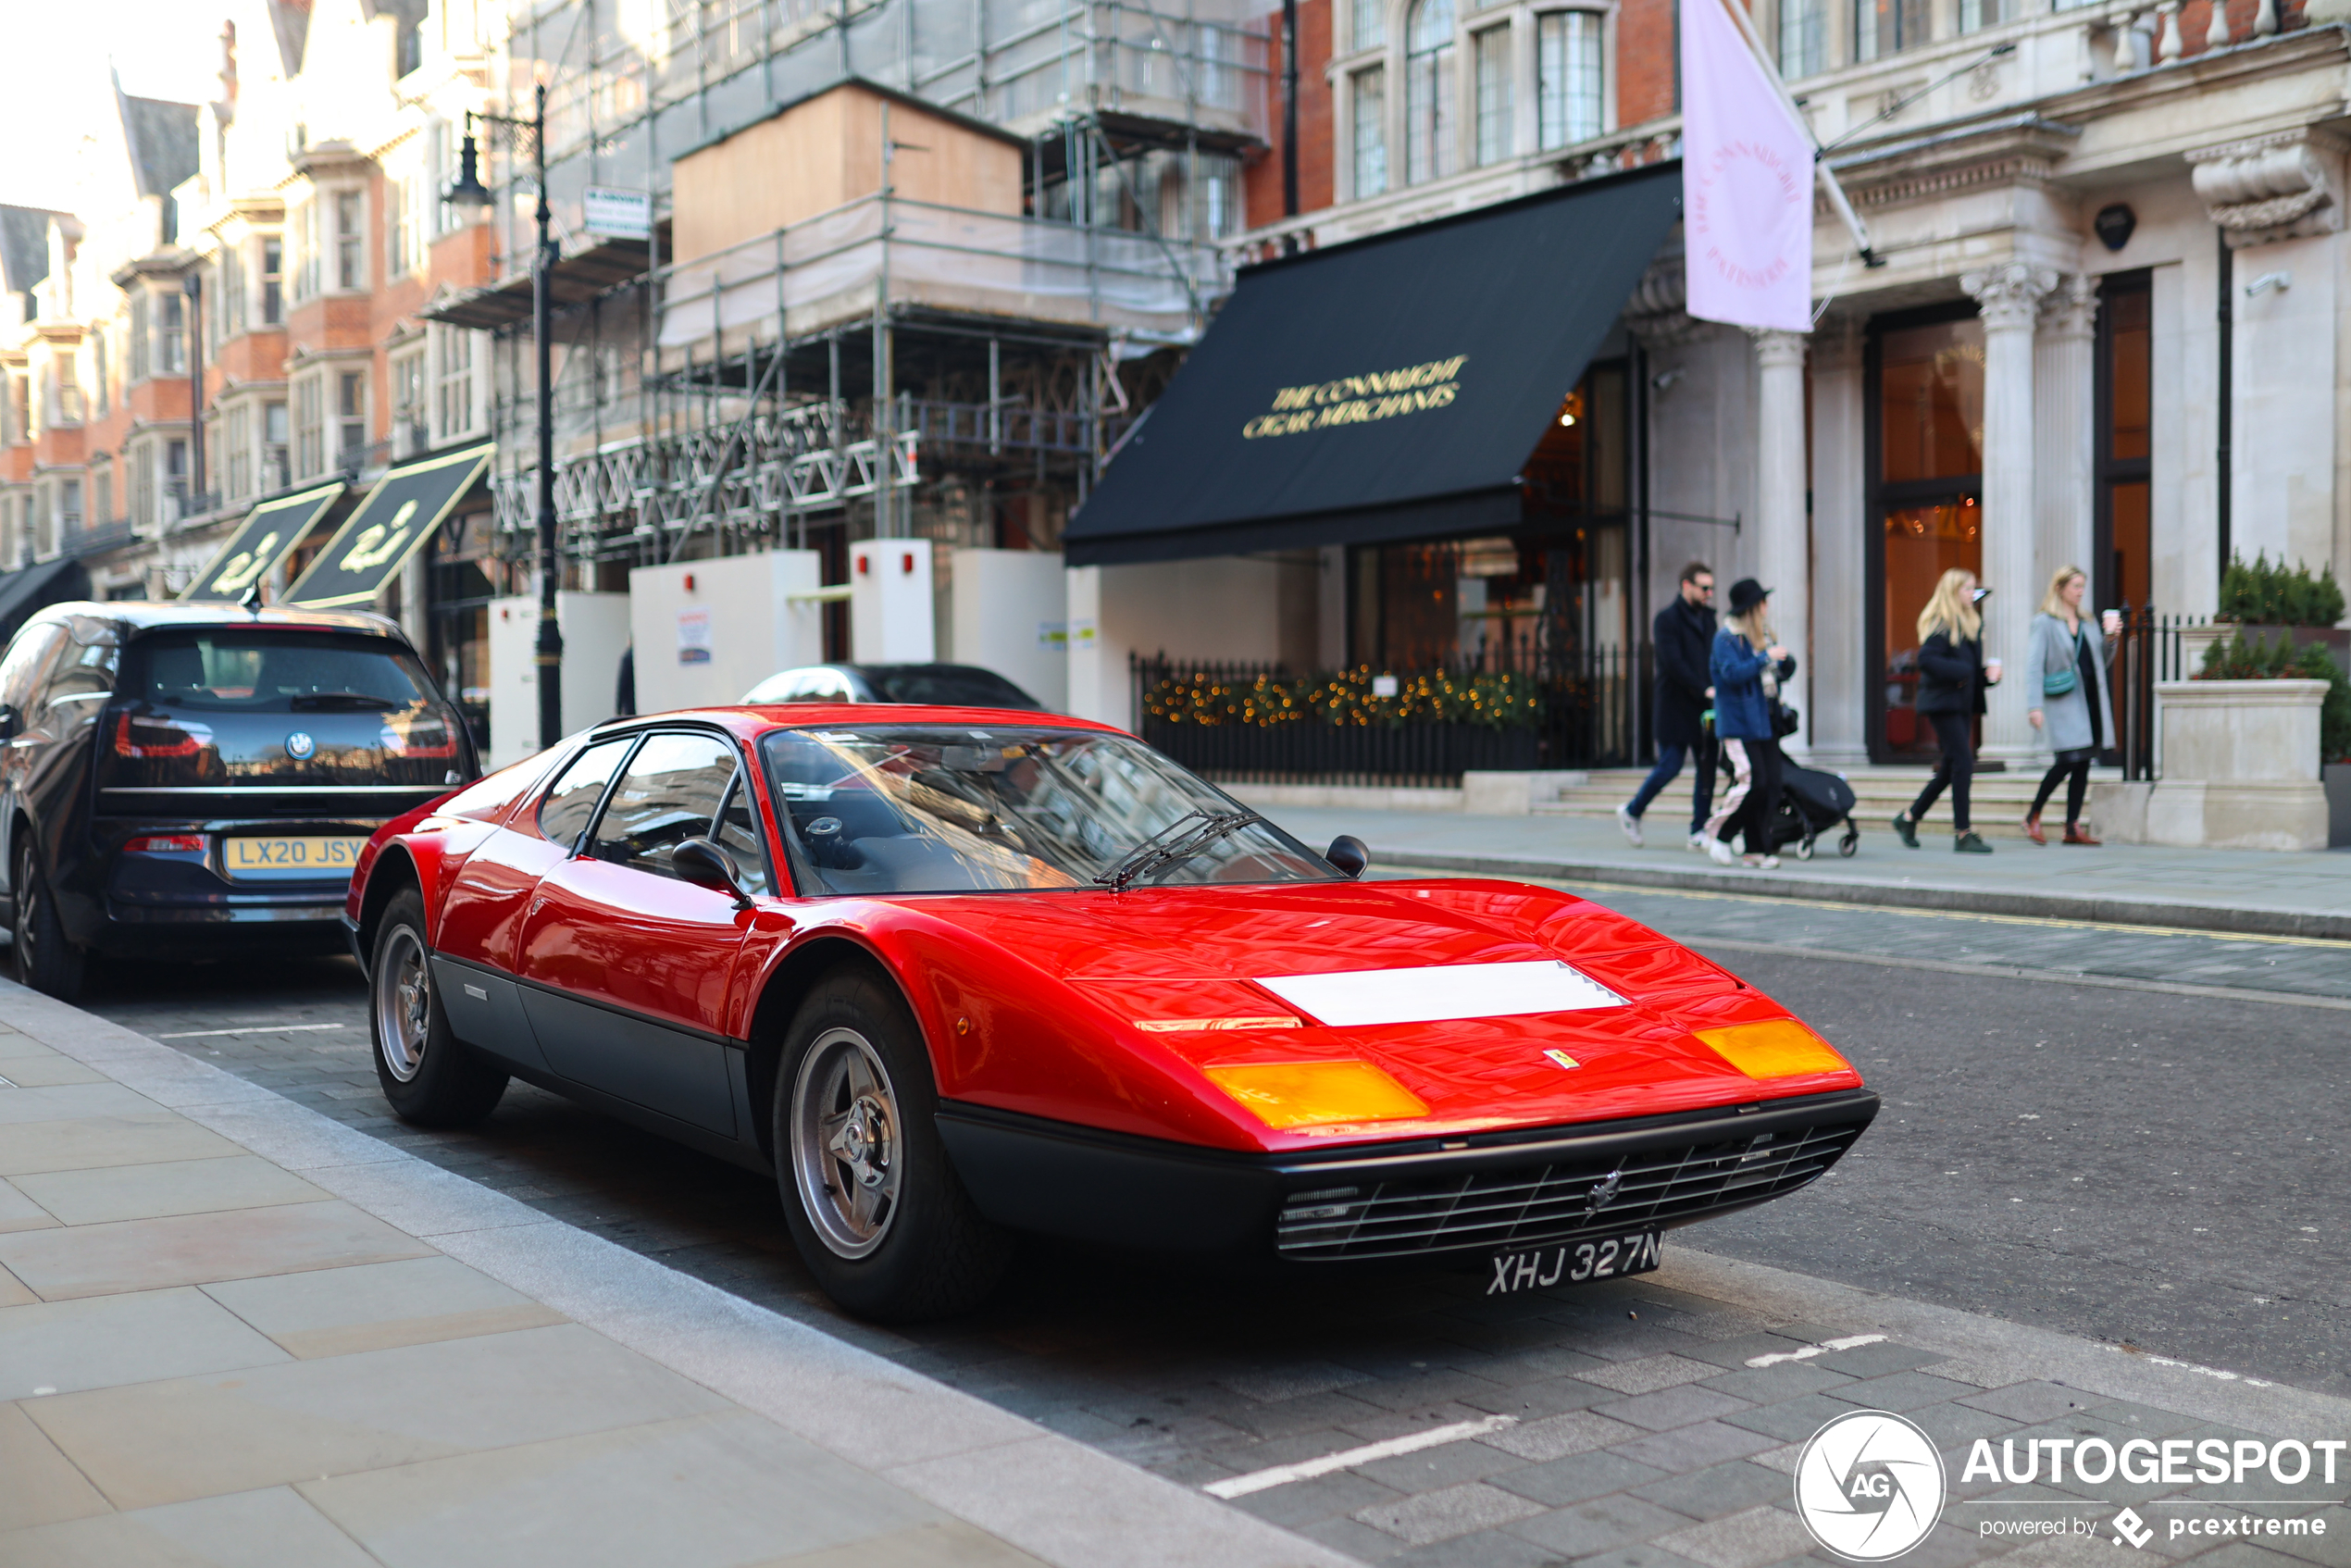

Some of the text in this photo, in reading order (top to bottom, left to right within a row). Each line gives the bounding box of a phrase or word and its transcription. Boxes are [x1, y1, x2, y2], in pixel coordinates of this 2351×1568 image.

[1243, 381, 1461, 440] CIGAR MERCHANTS
[1271, 353, 1470, 412] THE CONNAUGHT
[239, 840, 362, 864] LX20 JSY
[1486, 1230, 1666, 1296] XHJ 327N
